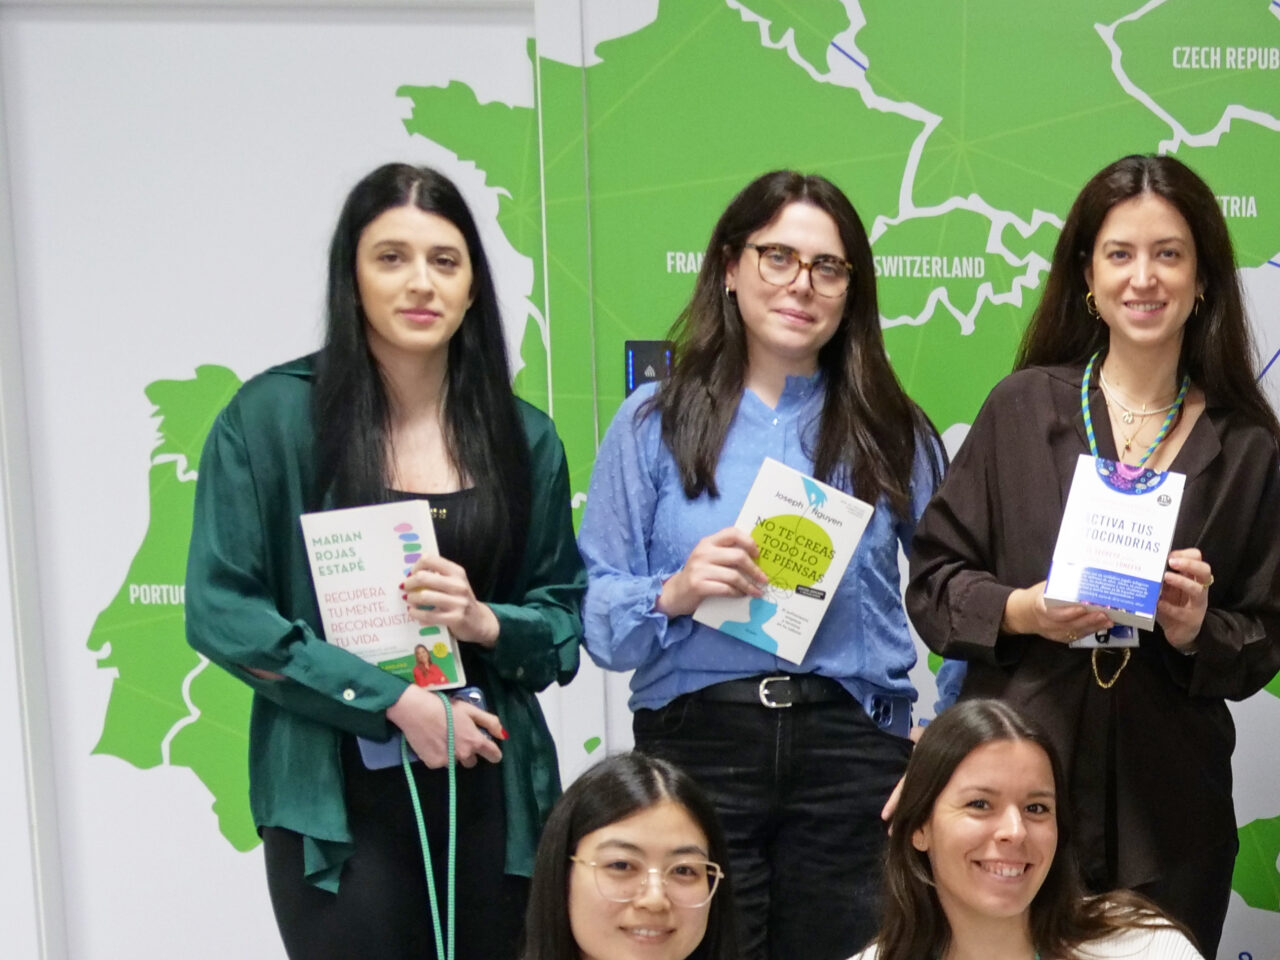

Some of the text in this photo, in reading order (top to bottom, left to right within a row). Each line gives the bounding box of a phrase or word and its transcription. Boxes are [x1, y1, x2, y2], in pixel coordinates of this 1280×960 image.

[1172, 46, 1221, 69] CZECH
[1215, 196, 1257, 217] TRIA
[873, 256, 985, 278] SWITZERLAND
[775, 491, 804, 509] Joseph
[811, 508, 843, 527] Nguyen
[1088, 512, 1153, 536] CTIVA TUS
[312, 531, 362, 546] MARIAN
[755, 516, 836, 560] NO TE CREAS
[315, 547, 356, 561] ROJAS
[763, 534, 818, 567] TODO LO
[319, 558, 365, 576] ESTAPÉ
[773, 556, 825, 584] PIENSAS
[130, 584, 185, 605] PORTU
[324, 587, 386, 603] RECUPERA
[328, 607, 343, 618] TU
[335, 633, 380, 648] TU VIDA
